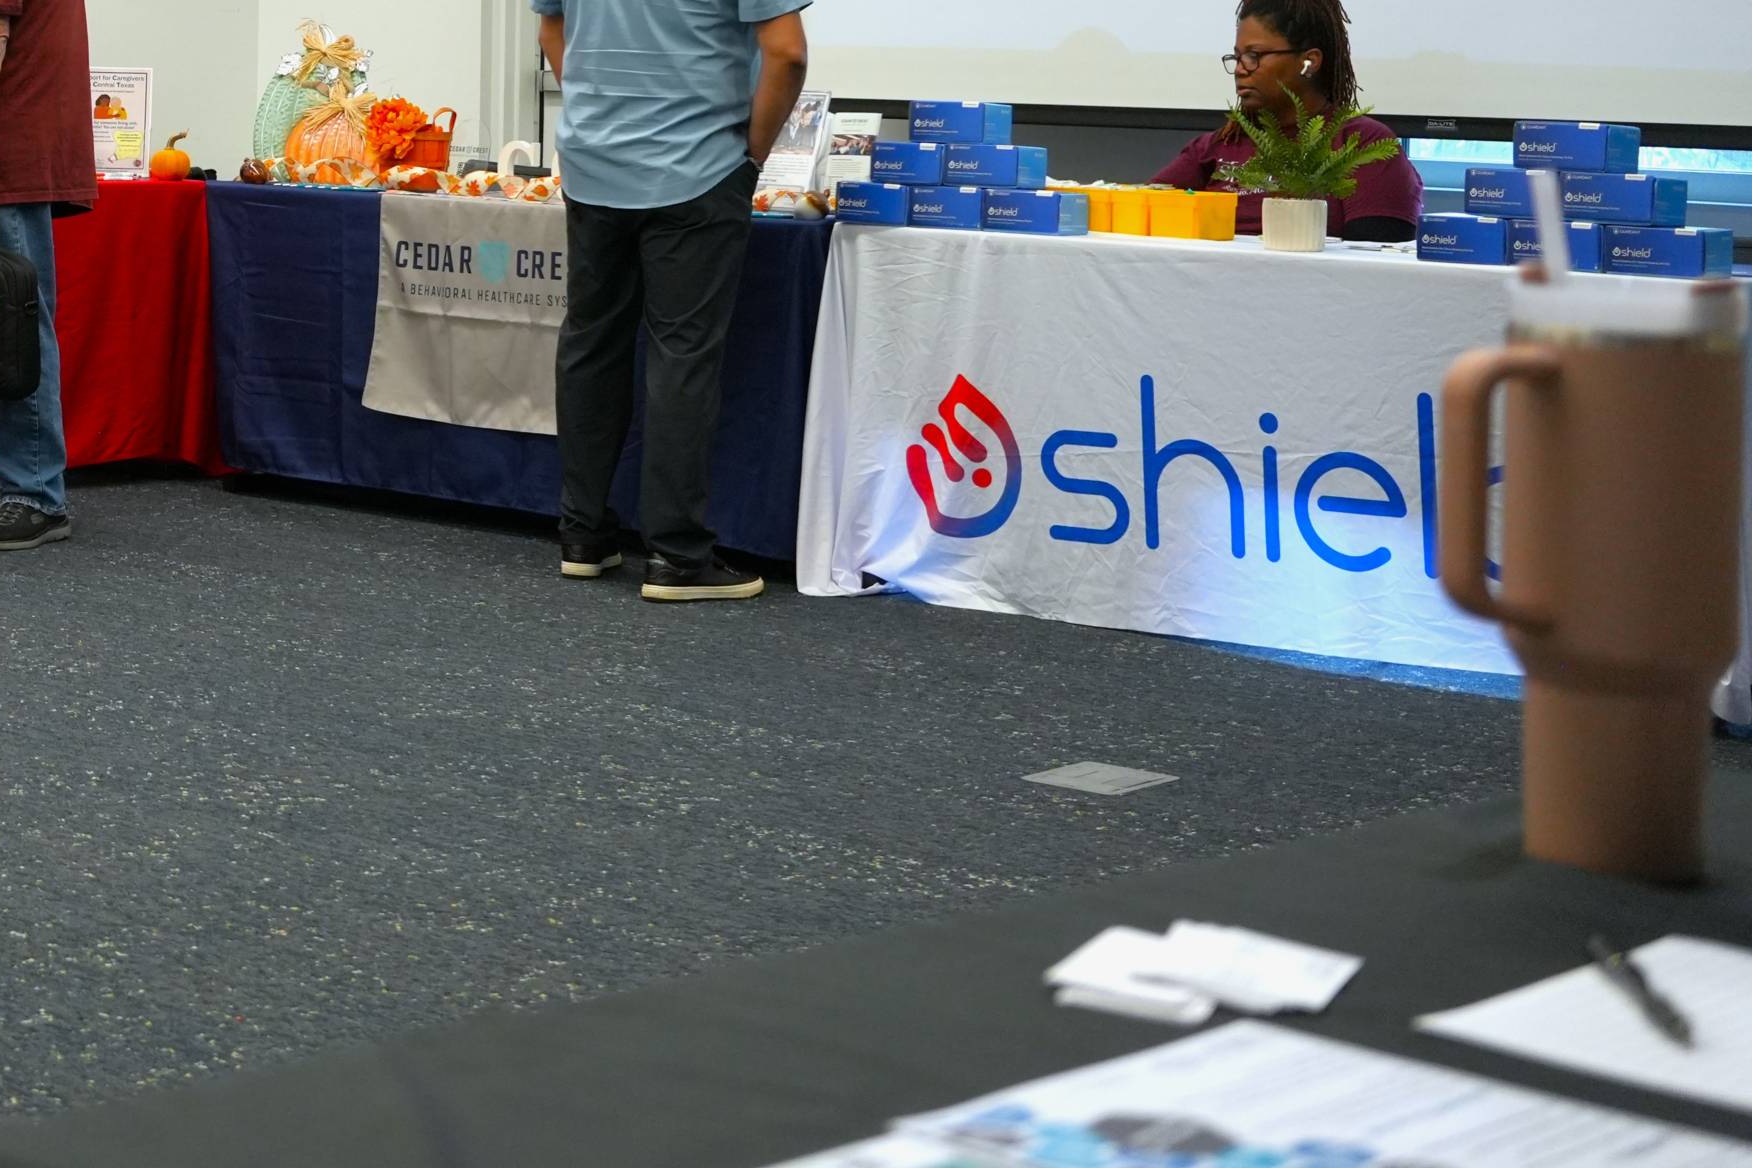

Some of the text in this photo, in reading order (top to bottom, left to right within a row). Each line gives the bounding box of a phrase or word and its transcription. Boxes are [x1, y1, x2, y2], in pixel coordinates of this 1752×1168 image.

[921, 119, 944, 128] shield
[1528, 141, 1556, 153] shield
[880, 161, 903, 170] shield
[955, 160, 978, 170] shield
[1478, 188, 1505, 198] shield
[1573, 193, 1602, 203] shield
[844, 199, 867, 208] shield
[919, 204, 943, 213] shield
[994, 207, 1018, 217] shield
[1429, 235, 1457, 245] shield
[1621, 247, 1652, 258] shield
[395, 240, 562, 280] CEDAR CRE
[410, 283, 473, 300] BEHAVIORAL
[477, 290, 541, 306] HEALTHCARE
[1041, 375, 1444, 579] shiel
